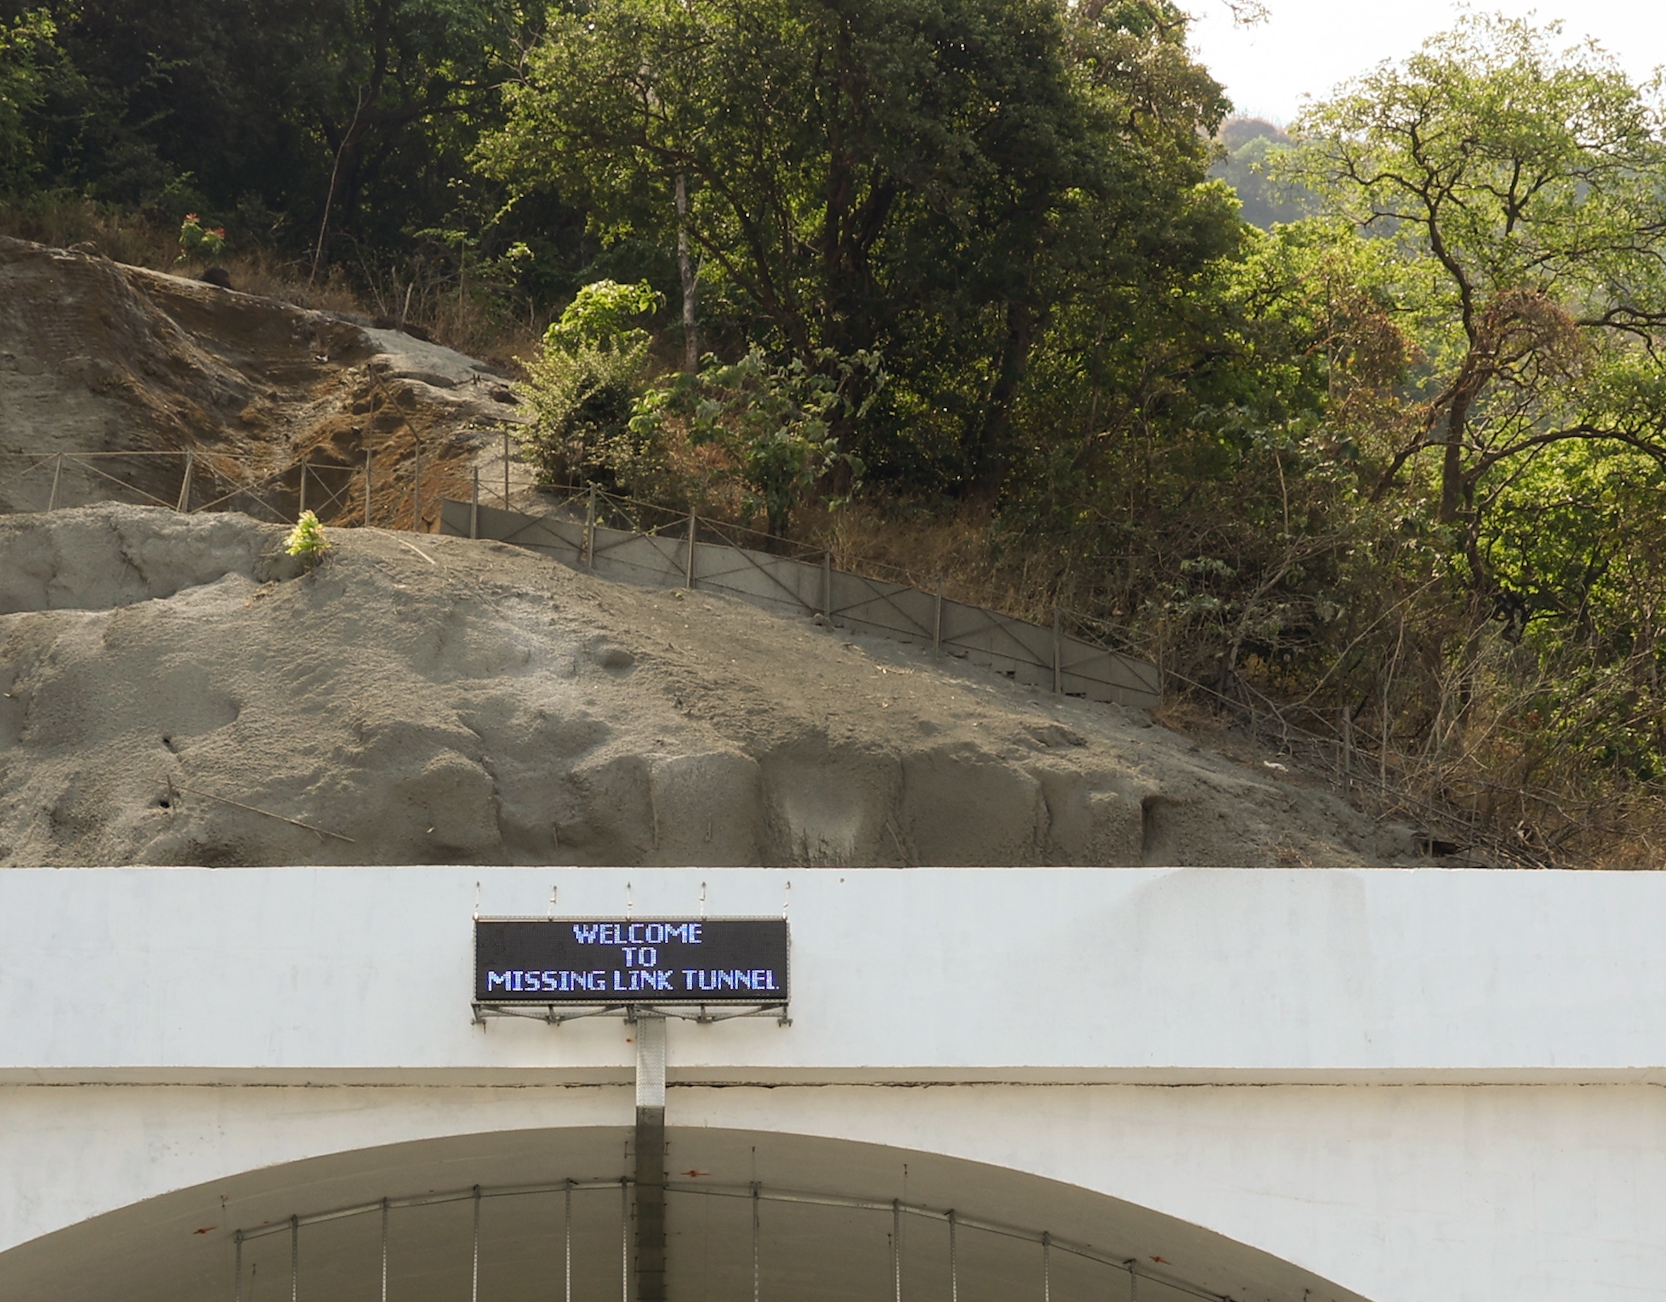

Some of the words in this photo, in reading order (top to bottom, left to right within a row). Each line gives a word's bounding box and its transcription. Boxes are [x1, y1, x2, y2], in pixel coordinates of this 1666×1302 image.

[573, 923, 702, 944] WELCOME
[622, 947, 657, 967] TO
[487, 970, 606, 991] MISSING
[613, 970, 674, 990] LINK
